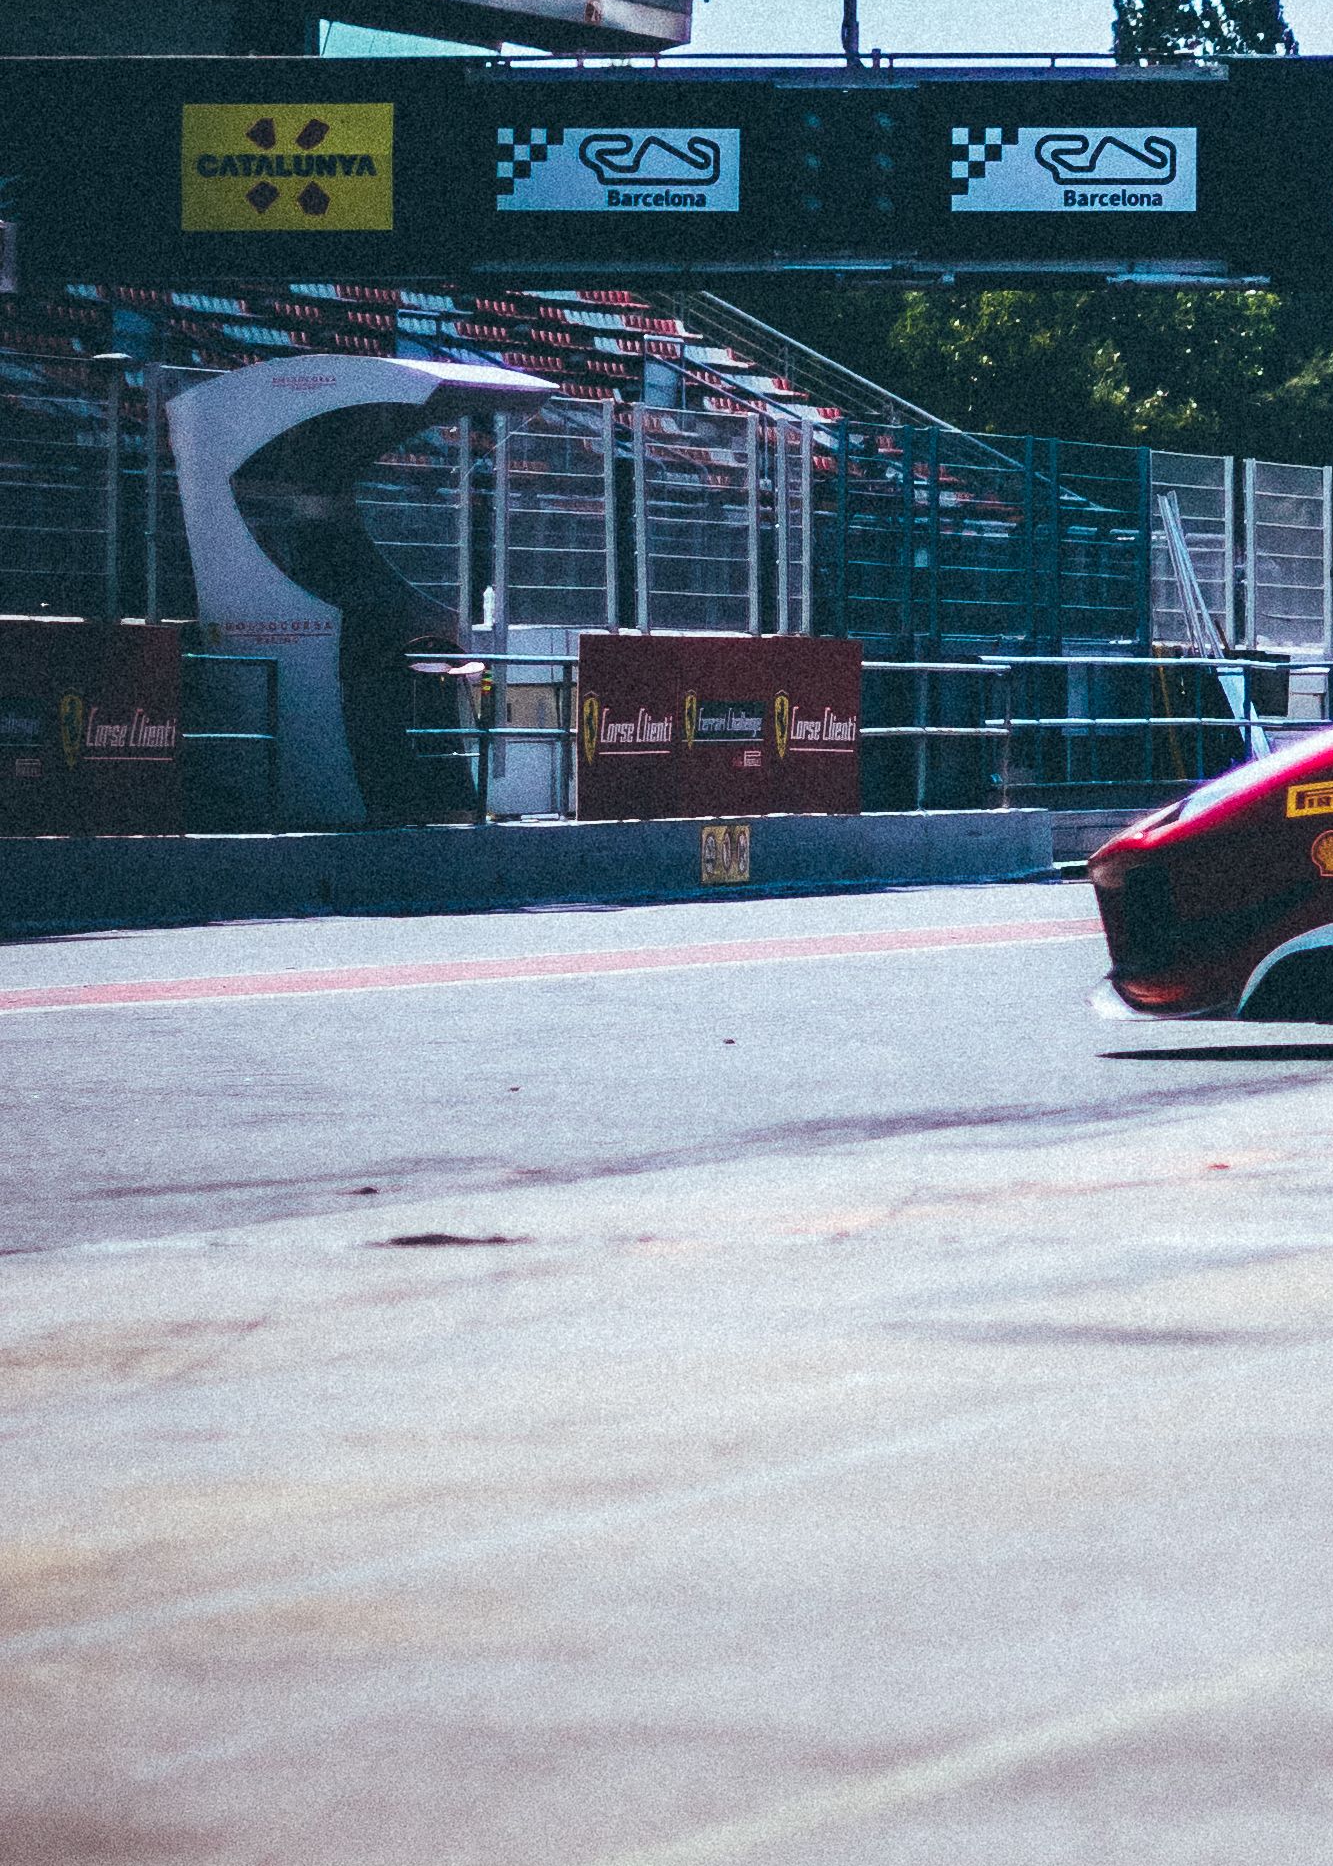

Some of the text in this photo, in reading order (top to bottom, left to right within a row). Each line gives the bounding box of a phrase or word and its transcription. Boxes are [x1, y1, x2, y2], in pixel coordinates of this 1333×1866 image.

[197, 153, 378, 178] CATALUNYA
[606, 188, 708, 208] Barcelona
[1063, 188, 1164, 208] Barcelona
[86, 707, 126, 747] Corse
[600, 708, 673, 744] Corse Clienti
[791, 706, 857, 741] Corse Clienti
